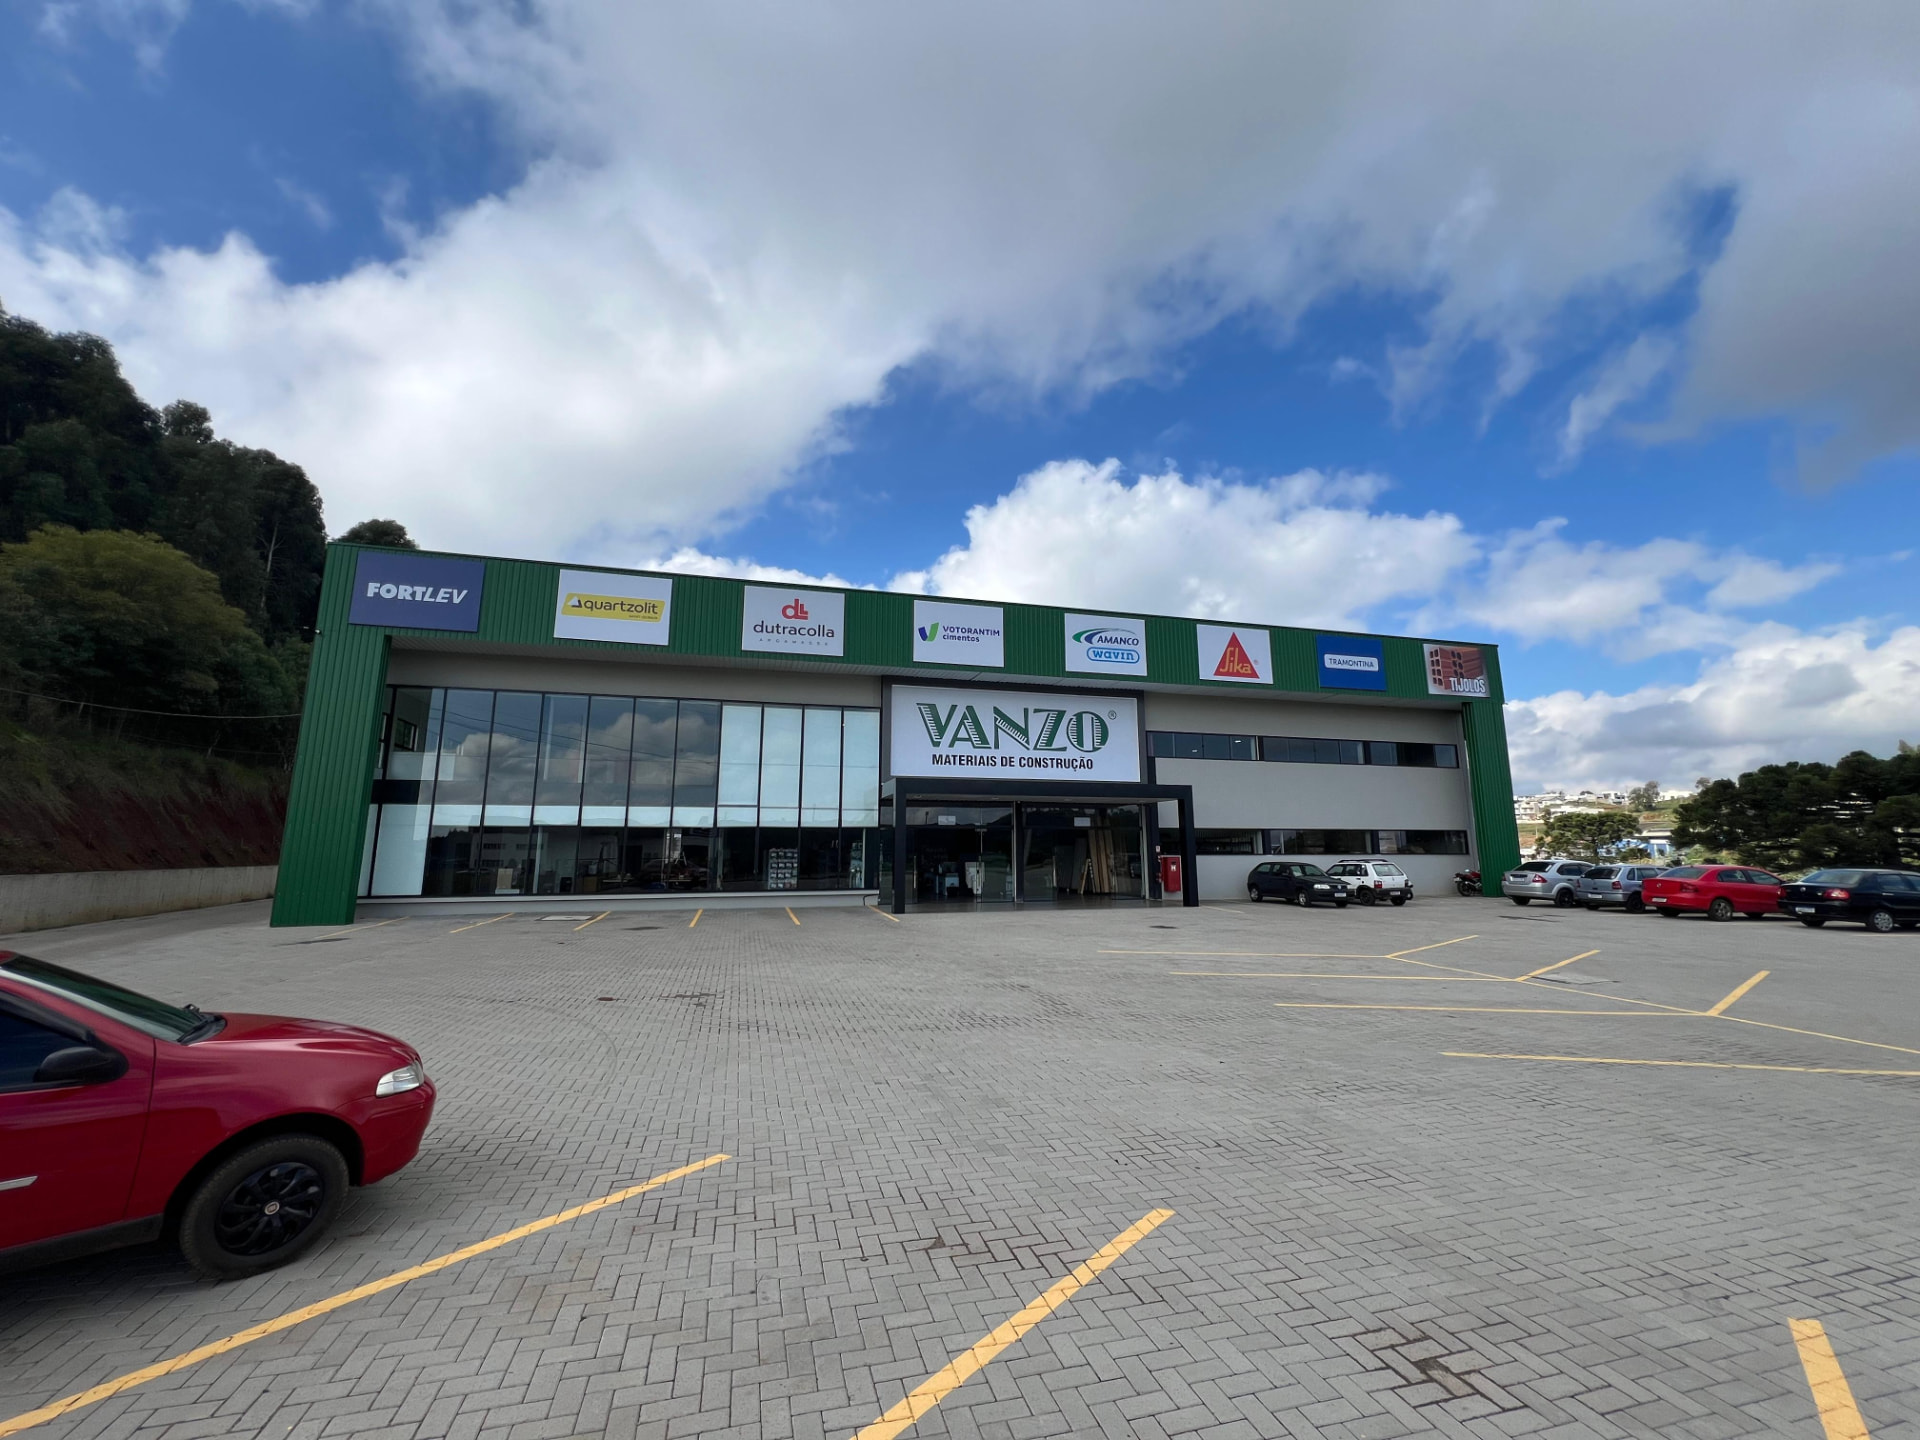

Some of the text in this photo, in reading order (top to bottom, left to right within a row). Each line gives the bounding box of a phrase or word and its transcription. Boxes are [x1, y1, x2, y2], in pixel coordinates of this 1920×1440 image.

[366, 582, 468, 604] FORTLEV
[583, 599, 658, 615] quartzolit
[753, 620, 835, 638] dutracolla
[942, 625, 1000, 636] VOTORANTIM
[942, 633, 980, 642] cimentos
[1097, 635, 1140, 646] AMANCO
[1092, 650, 1135, 661] wavin
[1219, 647, 1252, 674] Sika
[1328, 657, 1375, 668] TRAMONTINA
[1449, 677, 1486, 693] TIJOLOS
[915, 702, 1110, 753] VANZO
[932, 754, 1094, 771] MATERIAIS DE CONSTRUÇÃO
